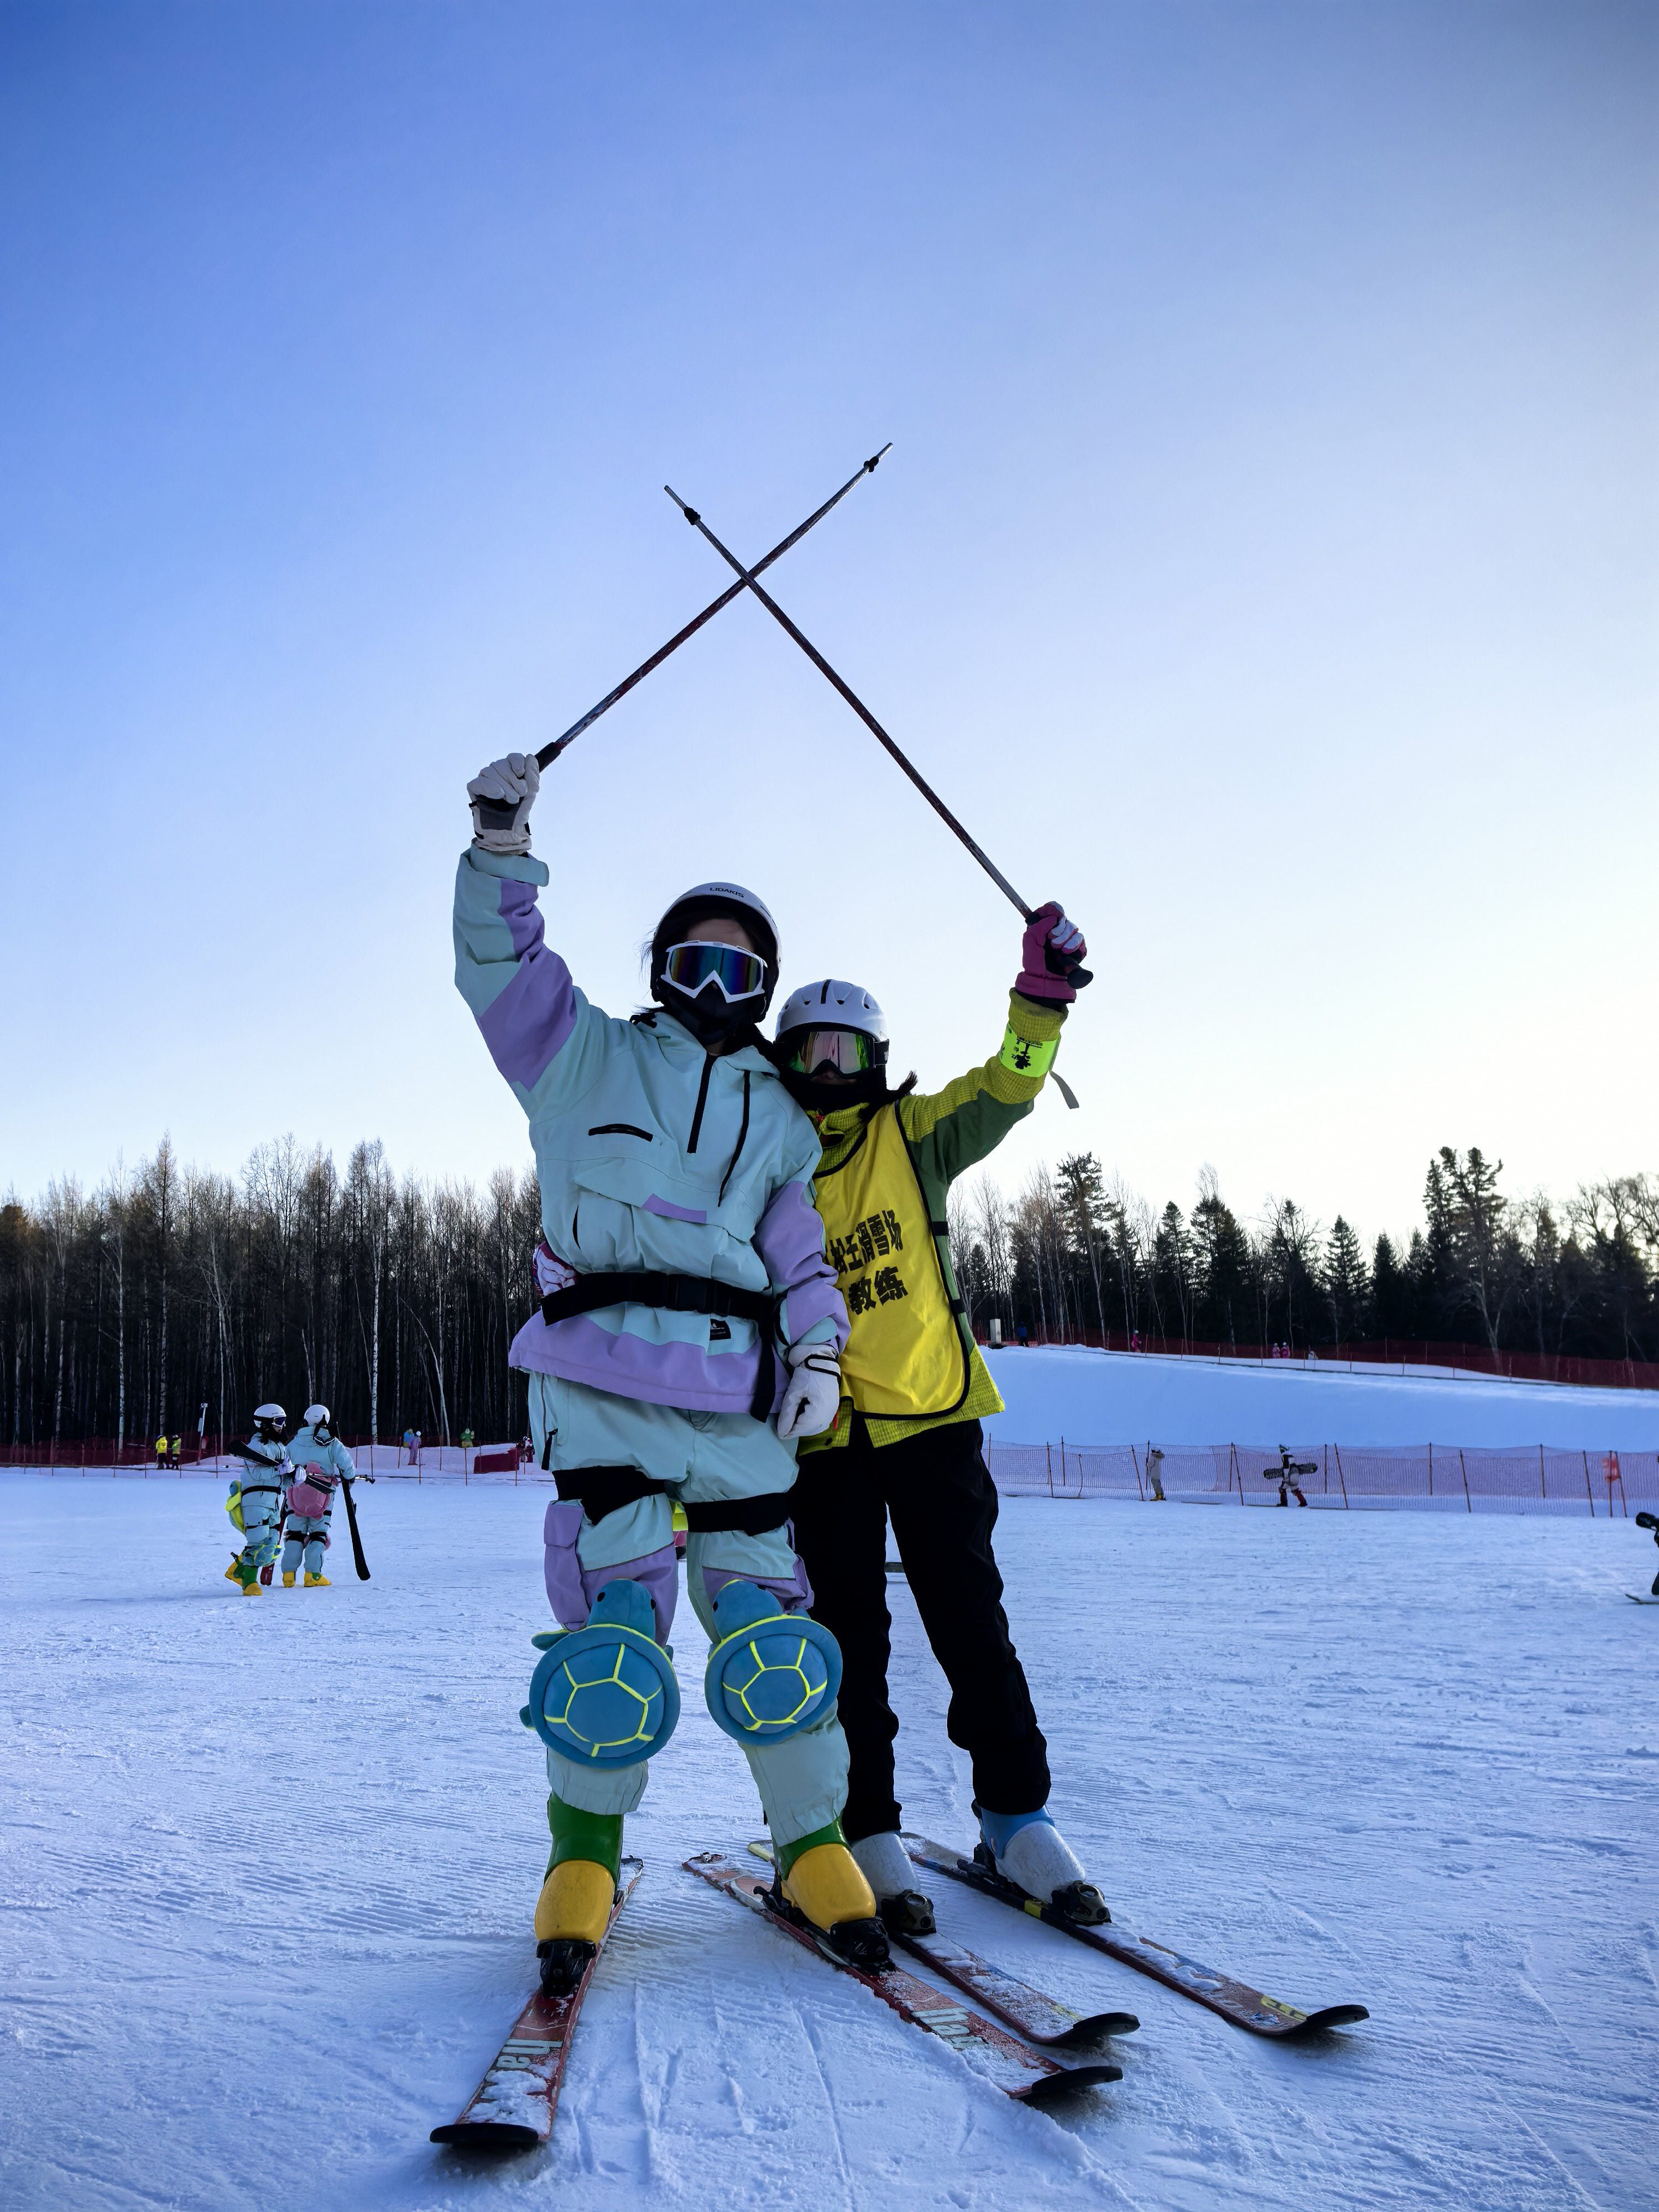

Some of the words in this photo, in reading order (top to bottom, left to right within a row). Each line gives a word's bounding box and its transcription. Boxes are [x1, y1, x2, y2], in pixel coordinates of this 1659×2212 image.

[709, 887, 744, 898] LIDAKIS
[825, 1209, 903, 1274] 松王滑雪场
[835, 1266, 909, 1315] 教练
